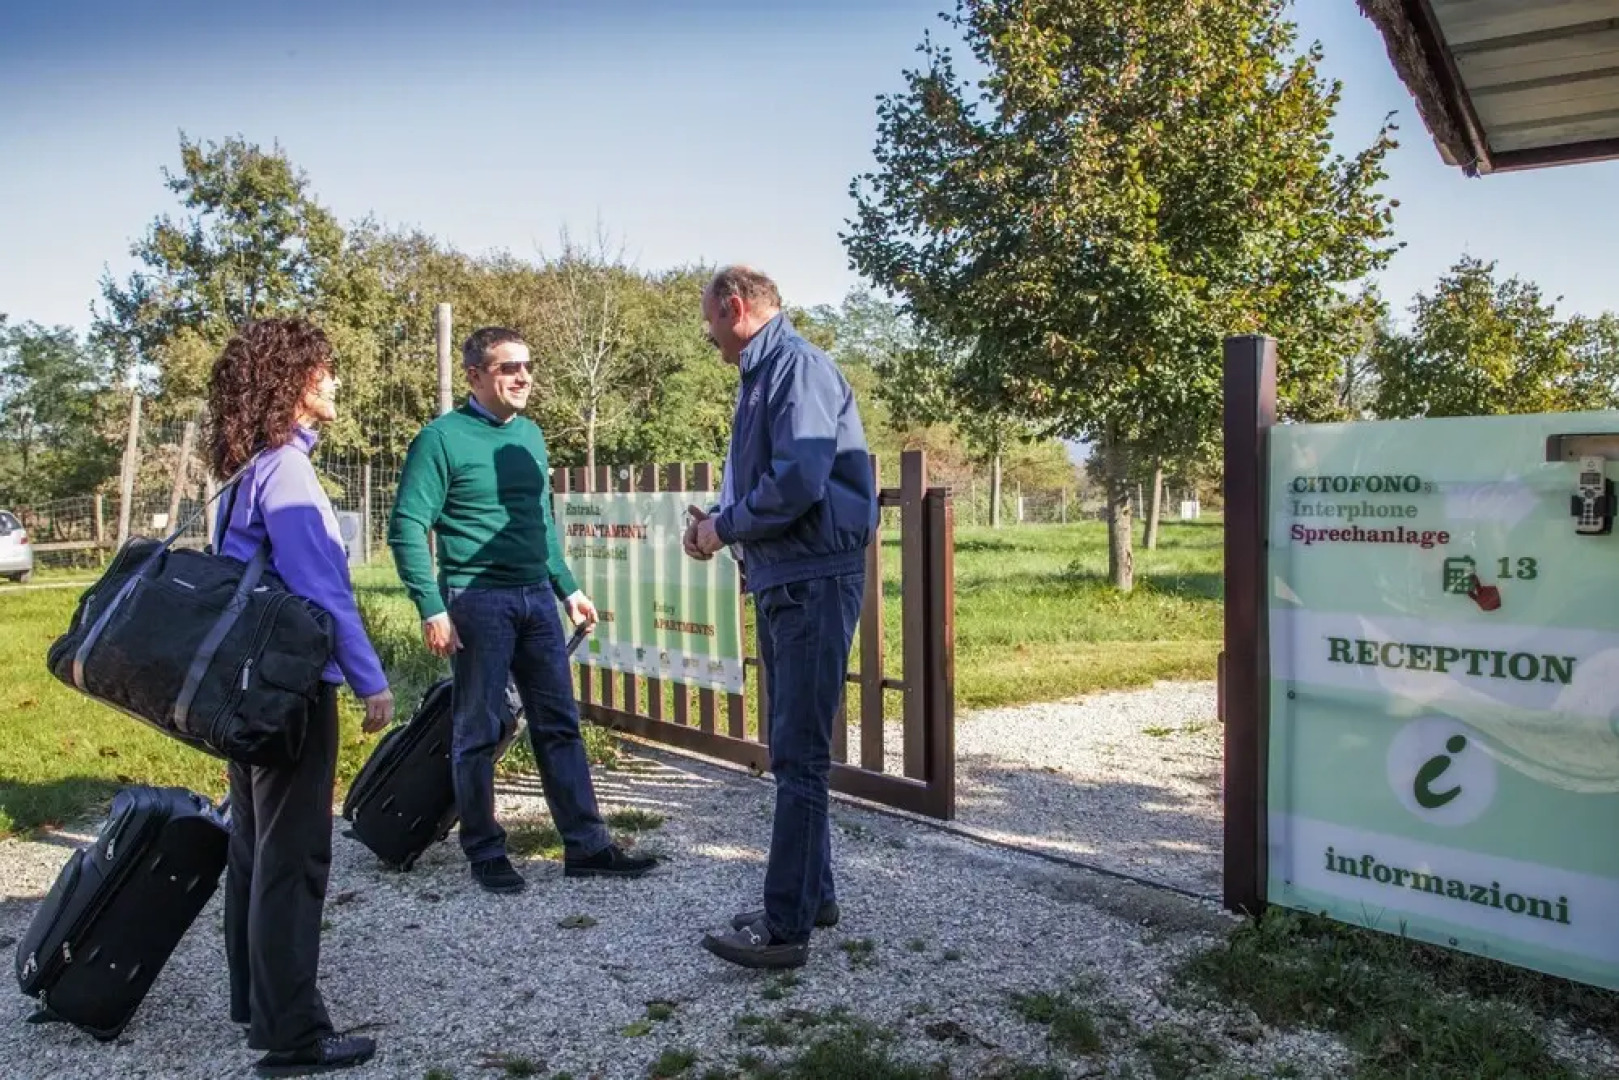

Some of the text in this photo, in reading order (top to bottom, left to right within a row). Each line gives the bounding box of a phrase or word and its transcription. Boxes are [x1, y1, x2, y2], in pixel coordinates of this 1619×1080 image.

[1293, 475, 1421, 493] CITOFONO
[1292, 500, 1418, 522] Interphone
[1291, 524, 1450, 549] Sprechanlage
[1497, 556, 1538, 580] 13
[1327, 637, 1577, 684] RECEPTION
[1325, 846, 1571, 925] informazioni
